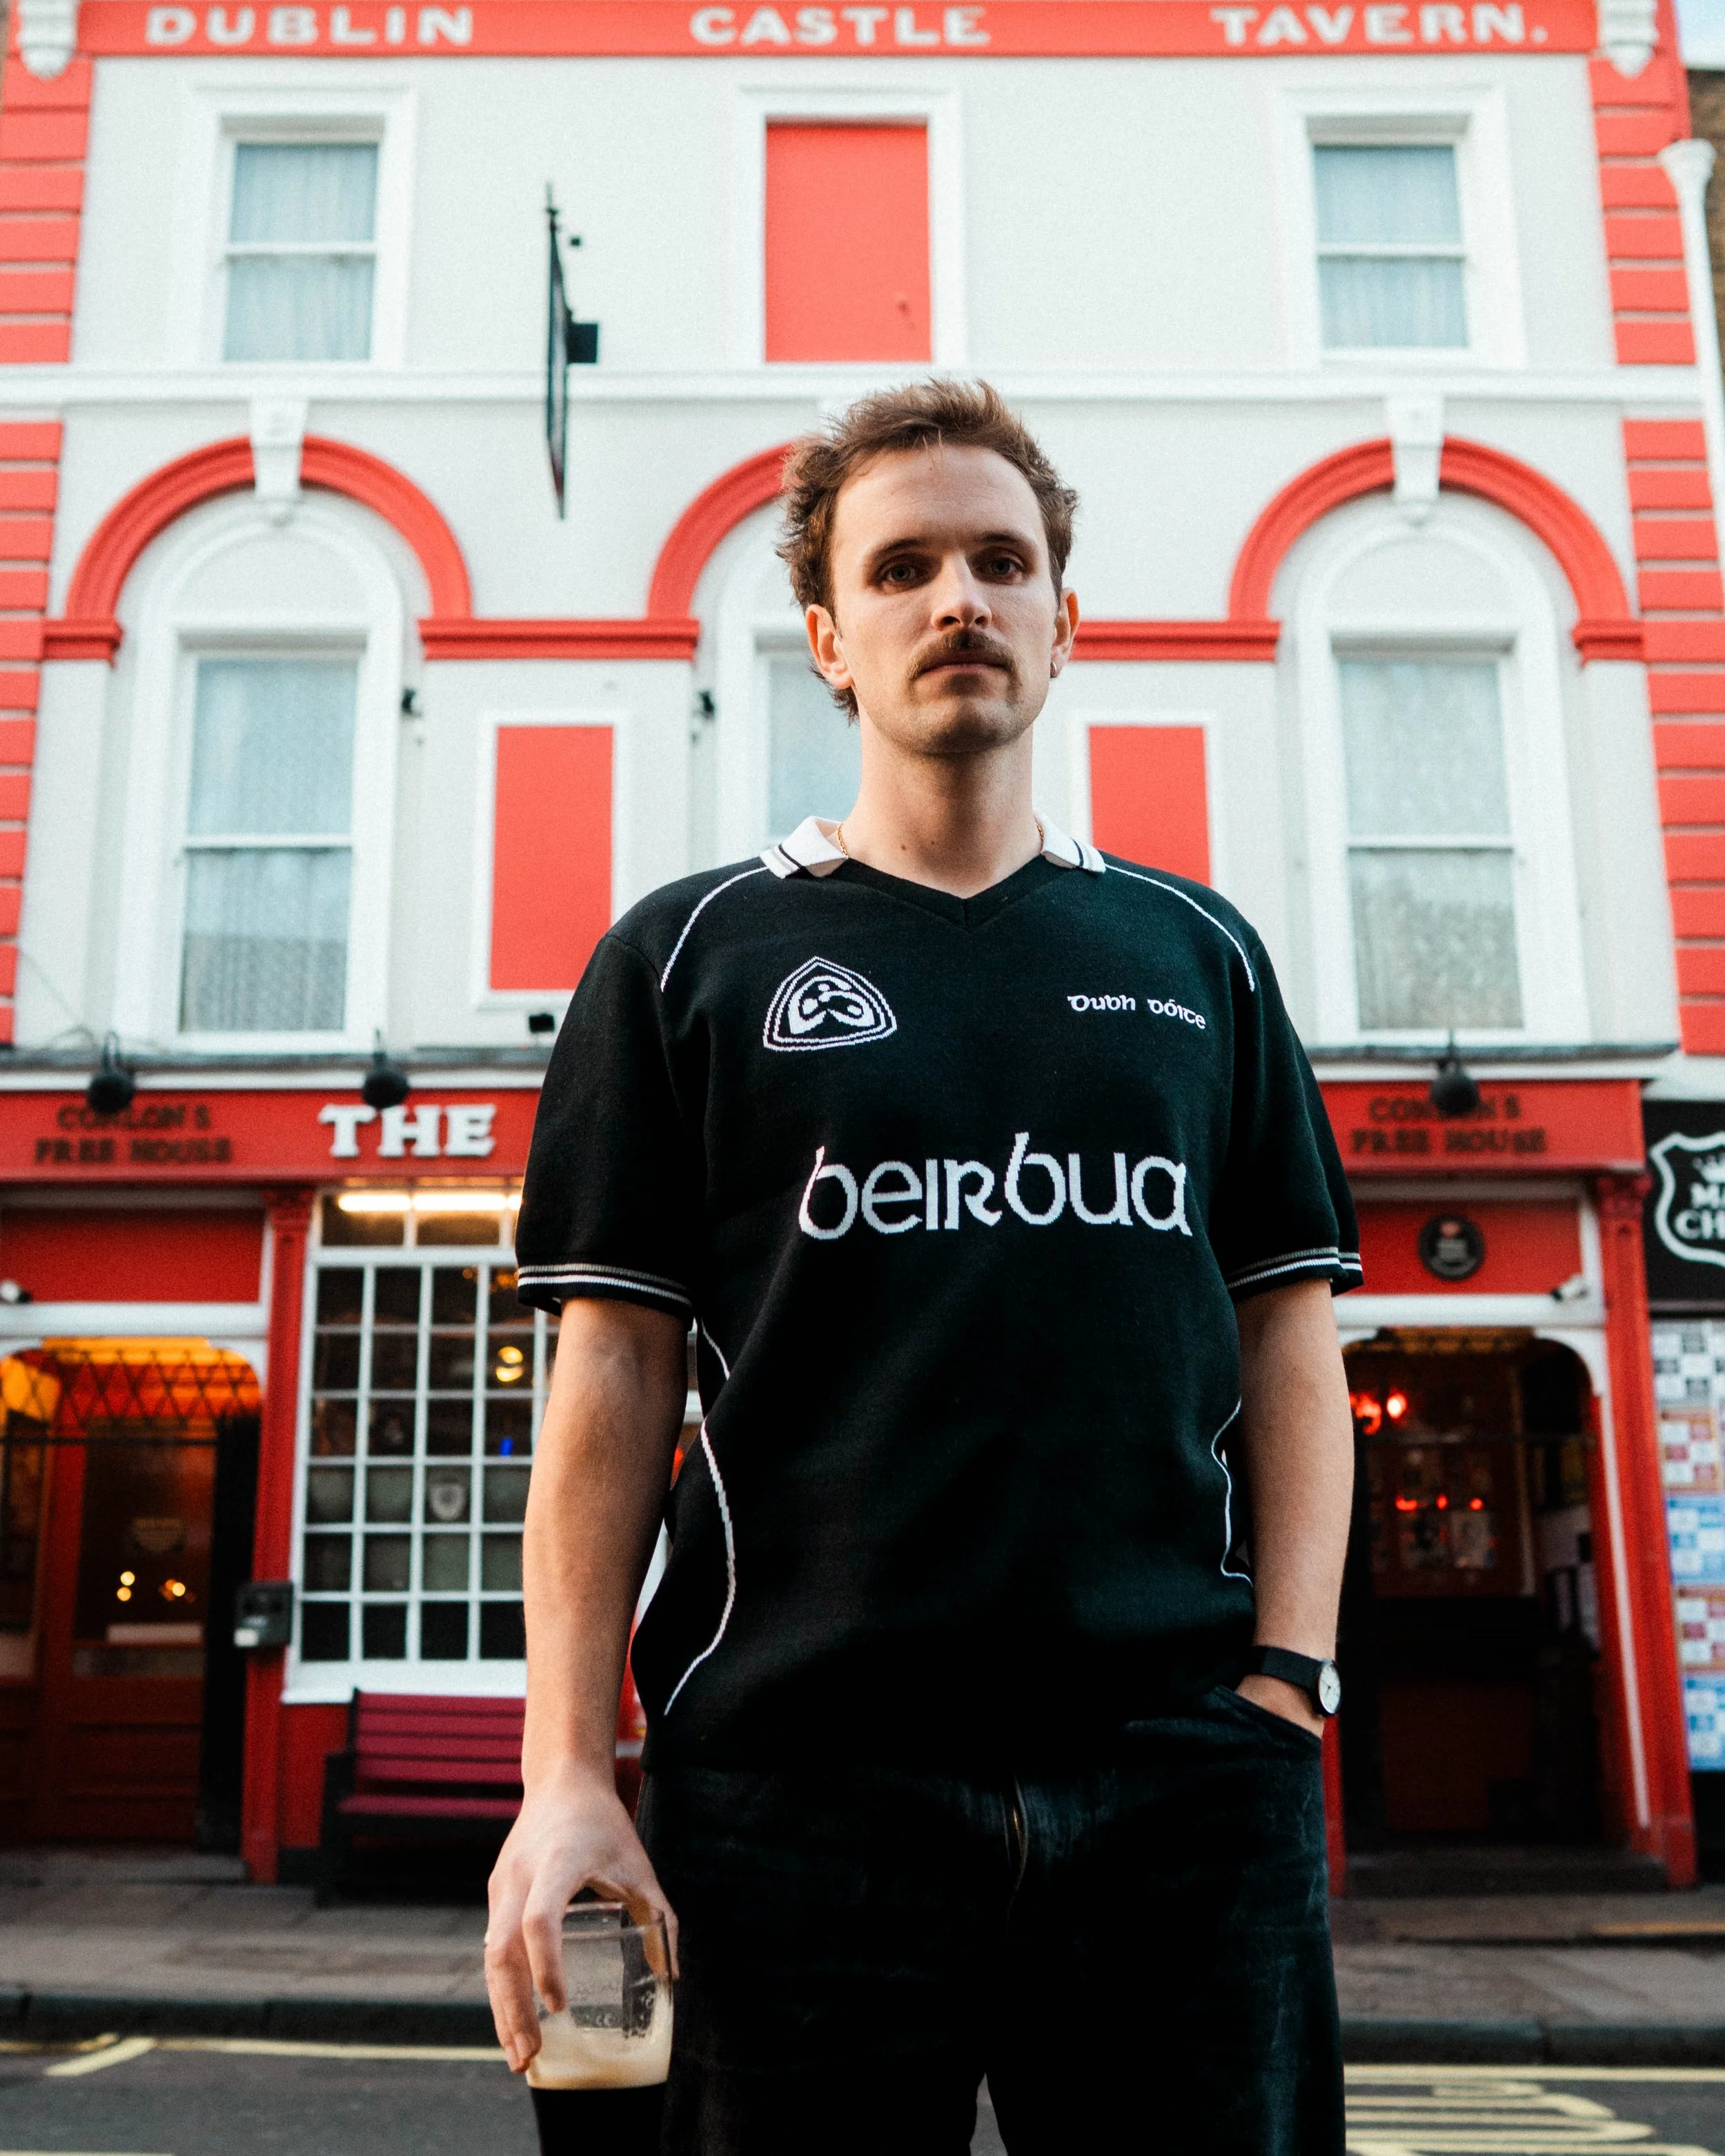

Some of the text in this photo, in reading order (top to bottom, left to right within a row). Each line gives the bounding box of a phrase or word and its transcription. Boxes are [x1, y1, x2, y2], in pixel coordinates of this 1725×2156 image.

[145, 3, 1548, 46] DUBLIN CASTLE TAVERN.
[318, 1103, 497, 1158] THE
[1352, 1126, 1547, 1154] FREE HOUSE
[36, 1138, 232, 1164] FREE HOUSE
